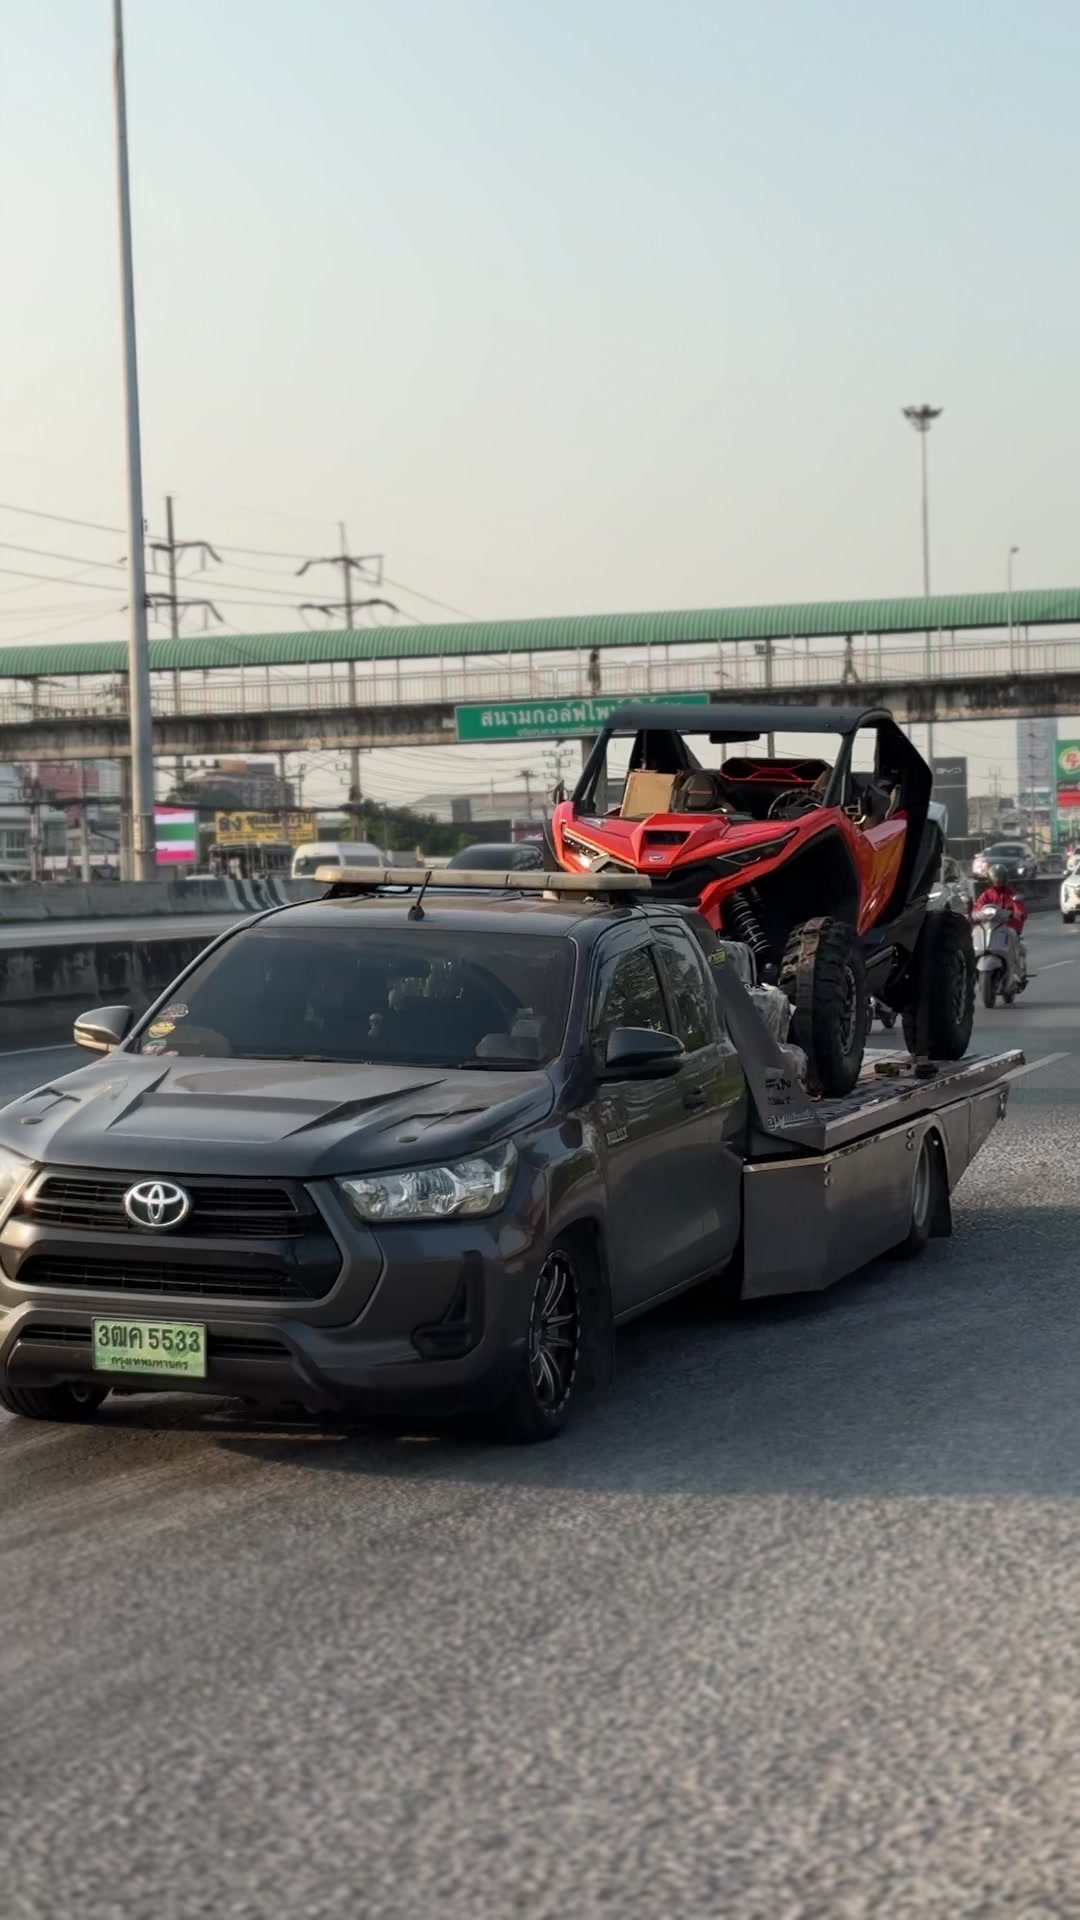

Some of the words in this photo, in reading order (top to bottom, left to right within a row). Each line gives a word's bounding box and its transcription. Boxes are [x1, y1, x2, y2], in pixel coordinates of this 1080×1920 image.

[148, 1328, 200, 1352] 5533
[111, 1356, 188, 1370] กรุงเทพมหานคร
